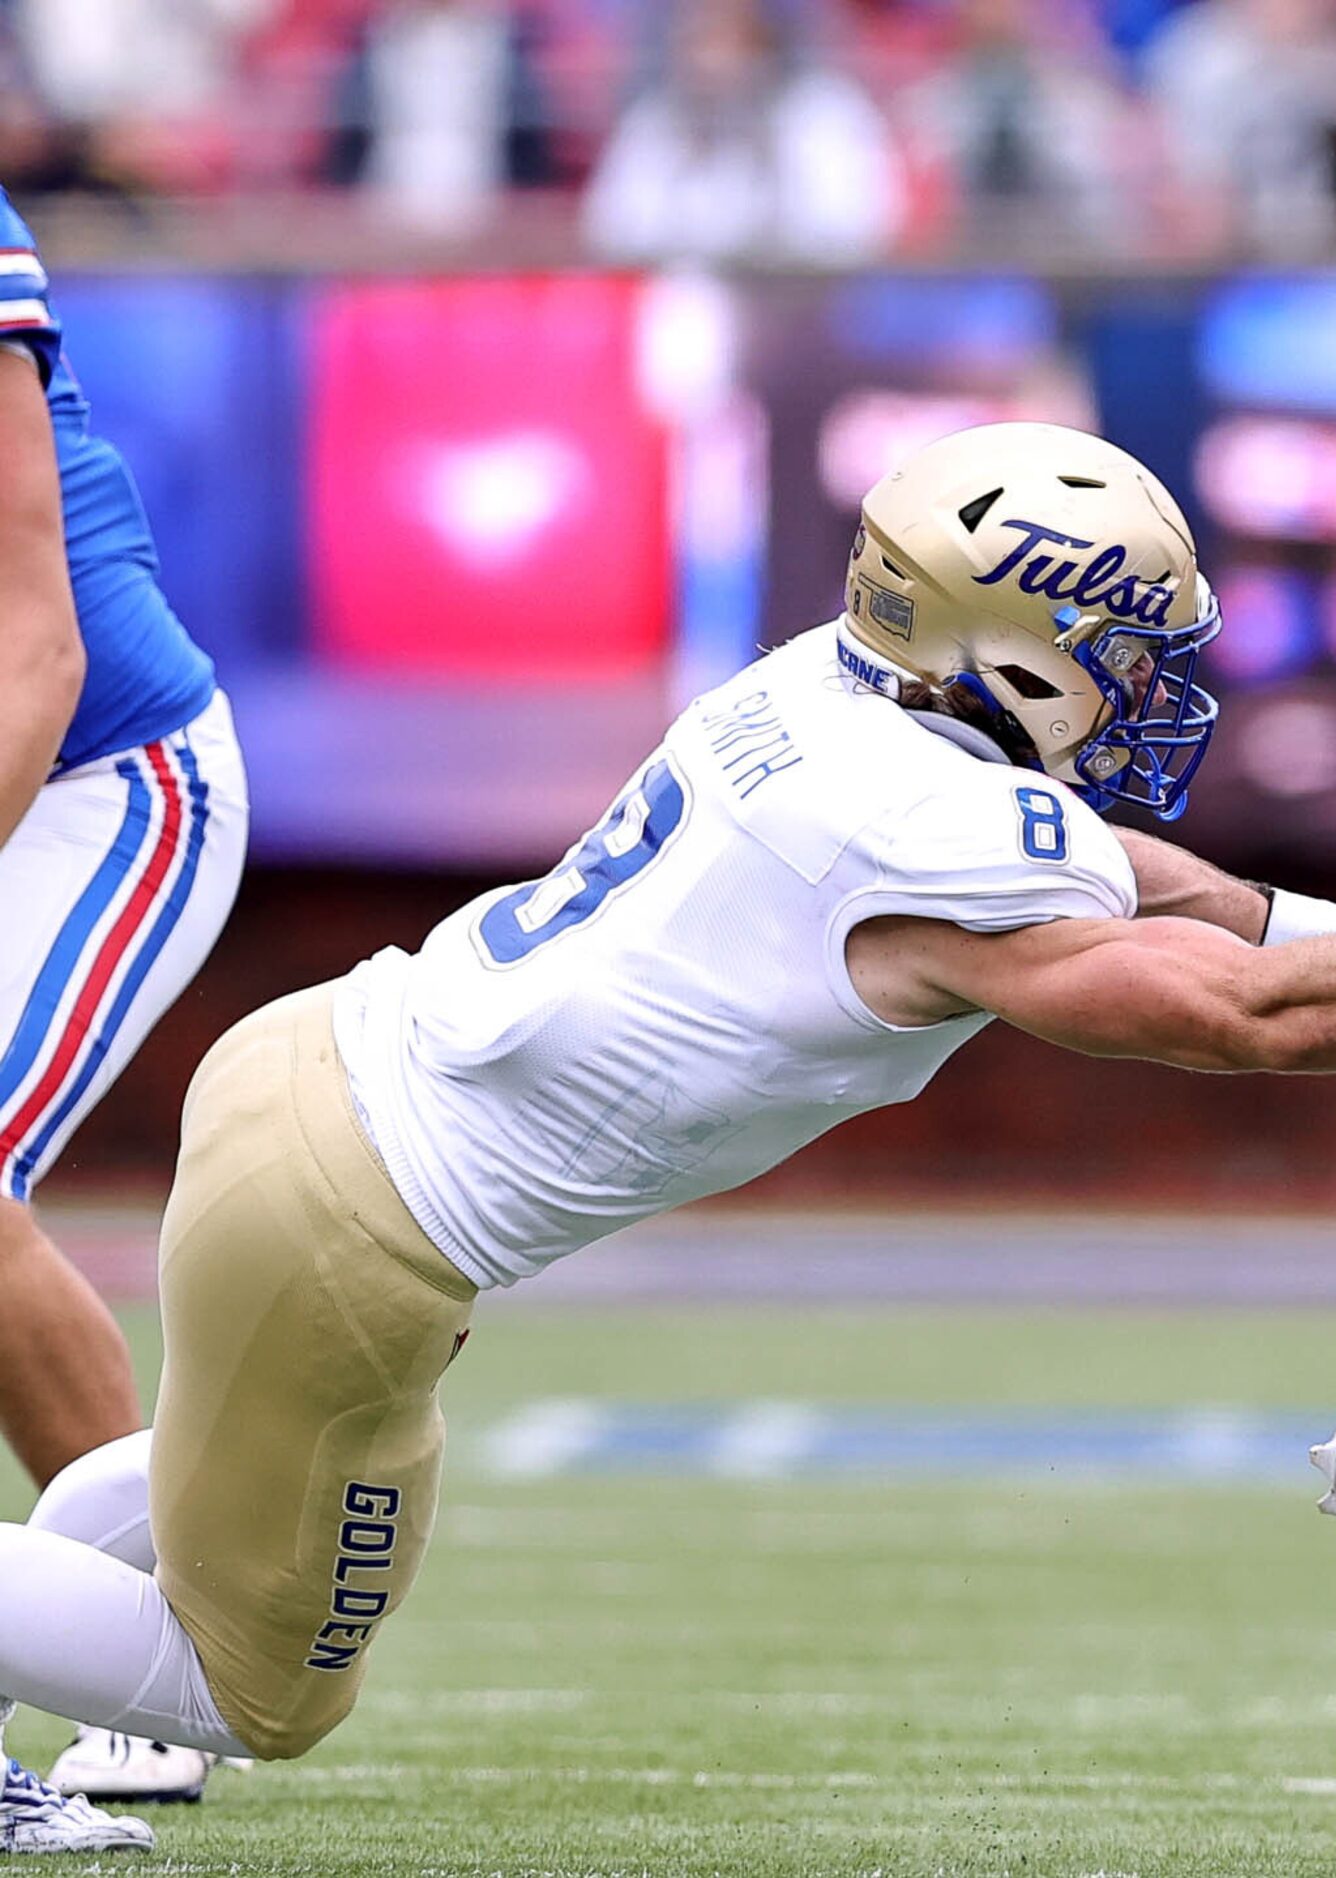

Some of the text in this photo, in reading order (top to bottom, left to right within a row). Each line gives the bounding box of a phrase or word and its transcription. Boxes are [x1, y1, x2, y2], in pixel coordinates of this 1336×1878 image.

[852, 588, 862, 617] 8
[971, 519, 1176, 627] Tulsa
[701, 690, 804, 801] SMITH
[474, 755, 688, 967] 8
[1013, 785, 1069, 863] 8
[303, 1480, 402, 1672] GOLDEN
